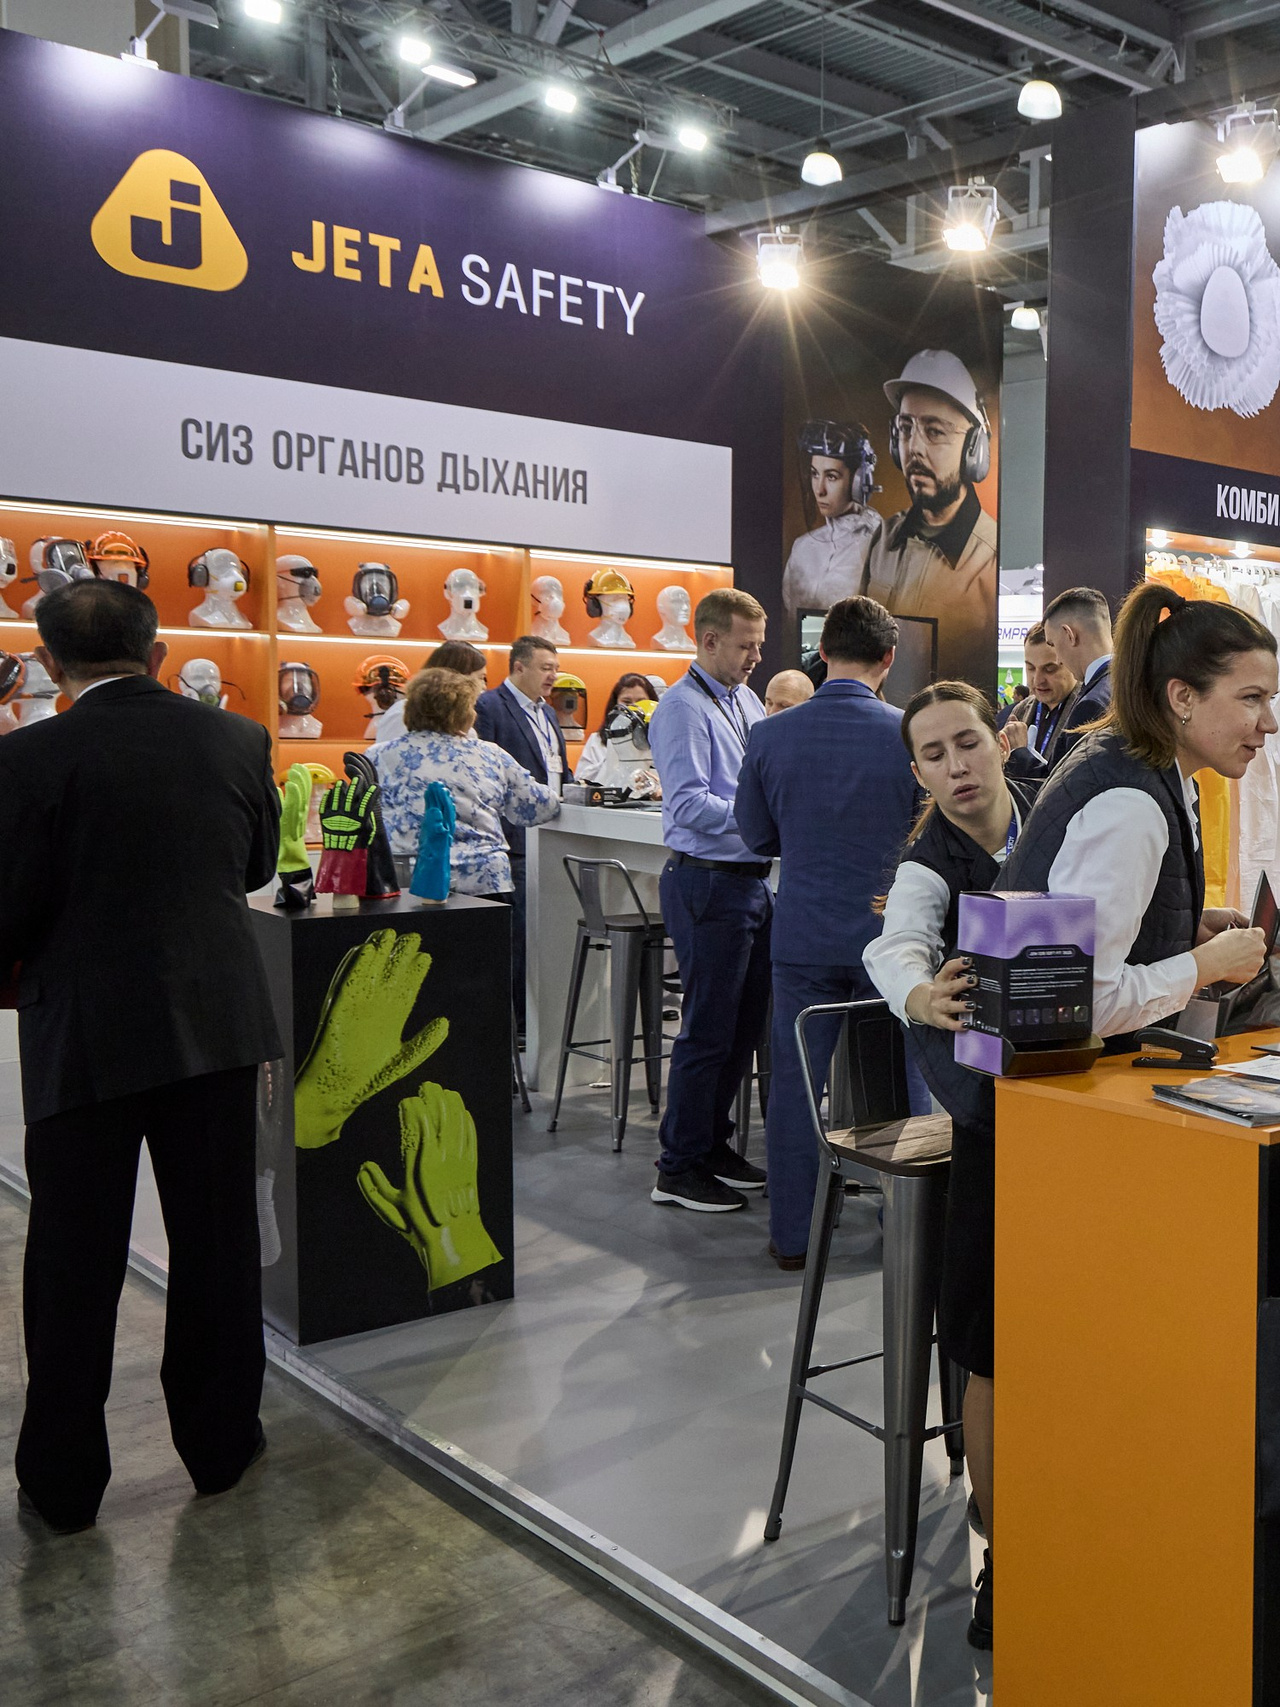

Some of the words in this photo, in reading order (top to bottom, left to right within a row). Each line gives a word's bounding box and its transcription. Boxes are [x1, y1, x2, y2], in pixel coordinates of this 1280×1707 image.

[291, 220, 444, 298] JETA
[461, 253, 646, 336] SAFETY
[180, 417, 254, 466] СИЗ
[272, 430, 426, 486] ОРГАНОВ
[436, 452, 589, 506] ДЫХАНИЯ
